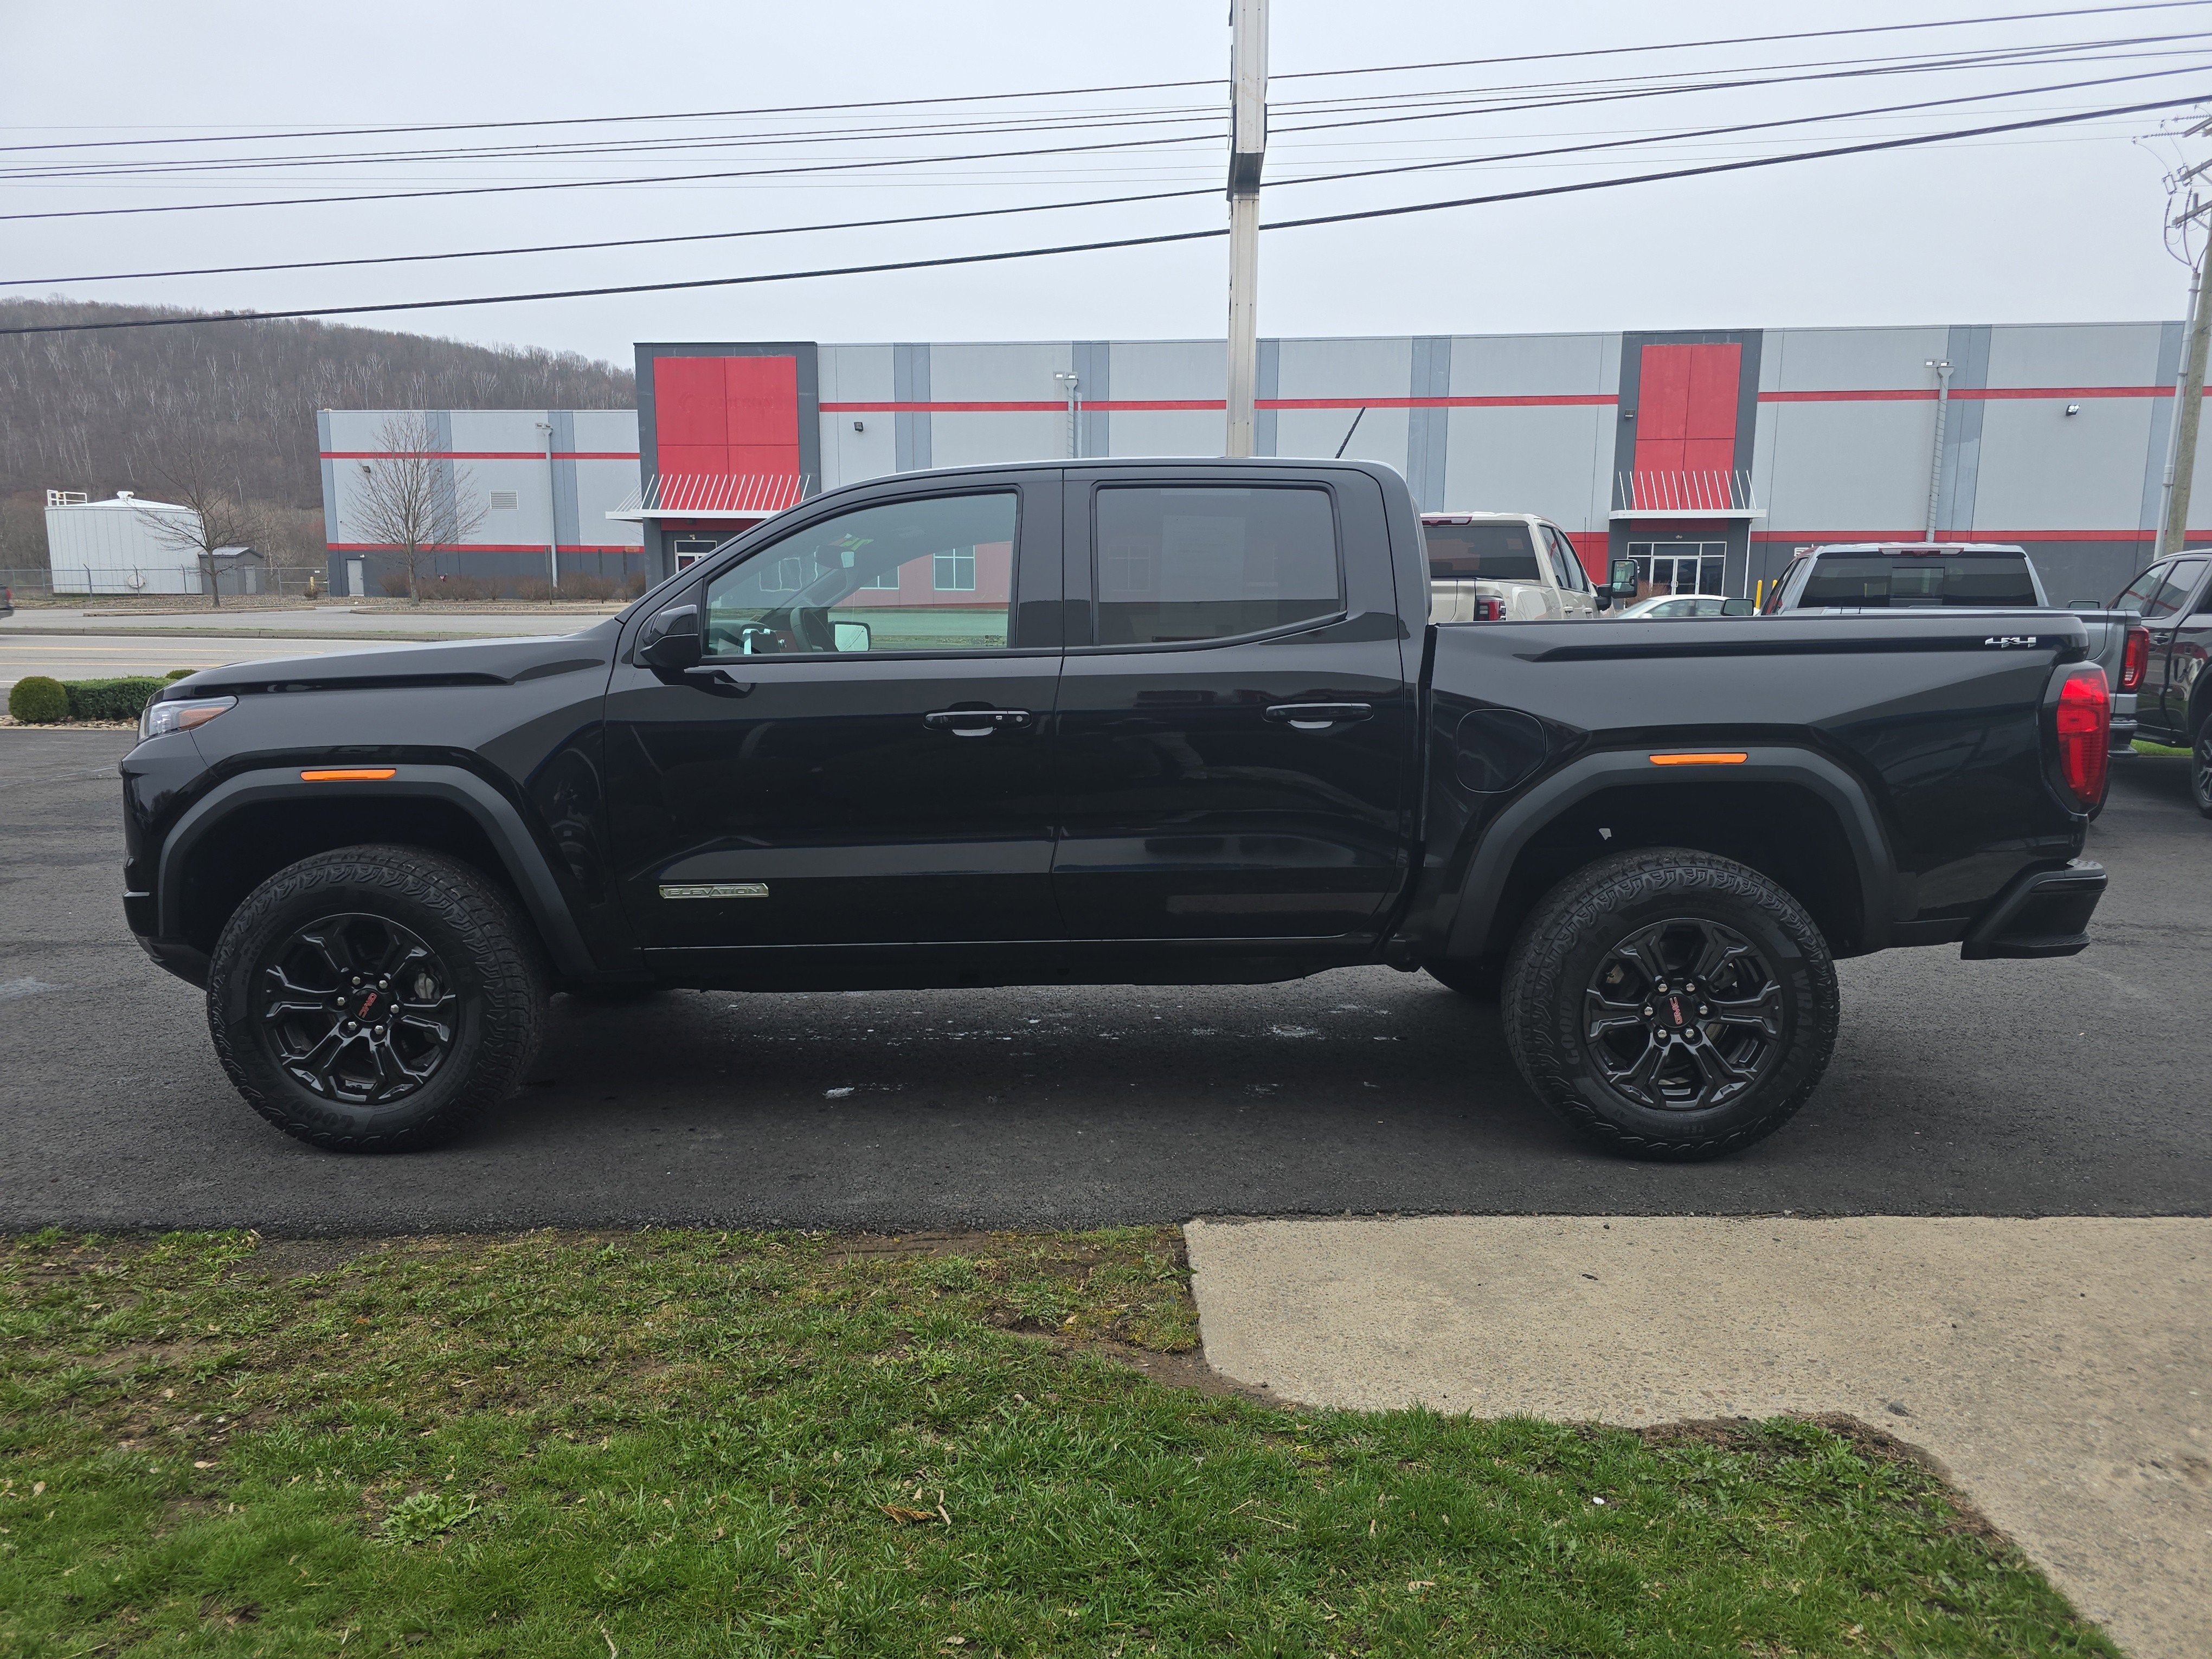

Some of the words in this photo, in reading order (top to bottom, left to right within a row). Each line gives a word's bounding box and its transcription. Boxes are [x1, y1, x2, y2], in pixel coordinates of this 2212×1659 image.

[668, 886, 760, 896] ELEVATION
[359, 993, 377, 1018] GMC
[1669, 996, 1683, 1024] GMC
